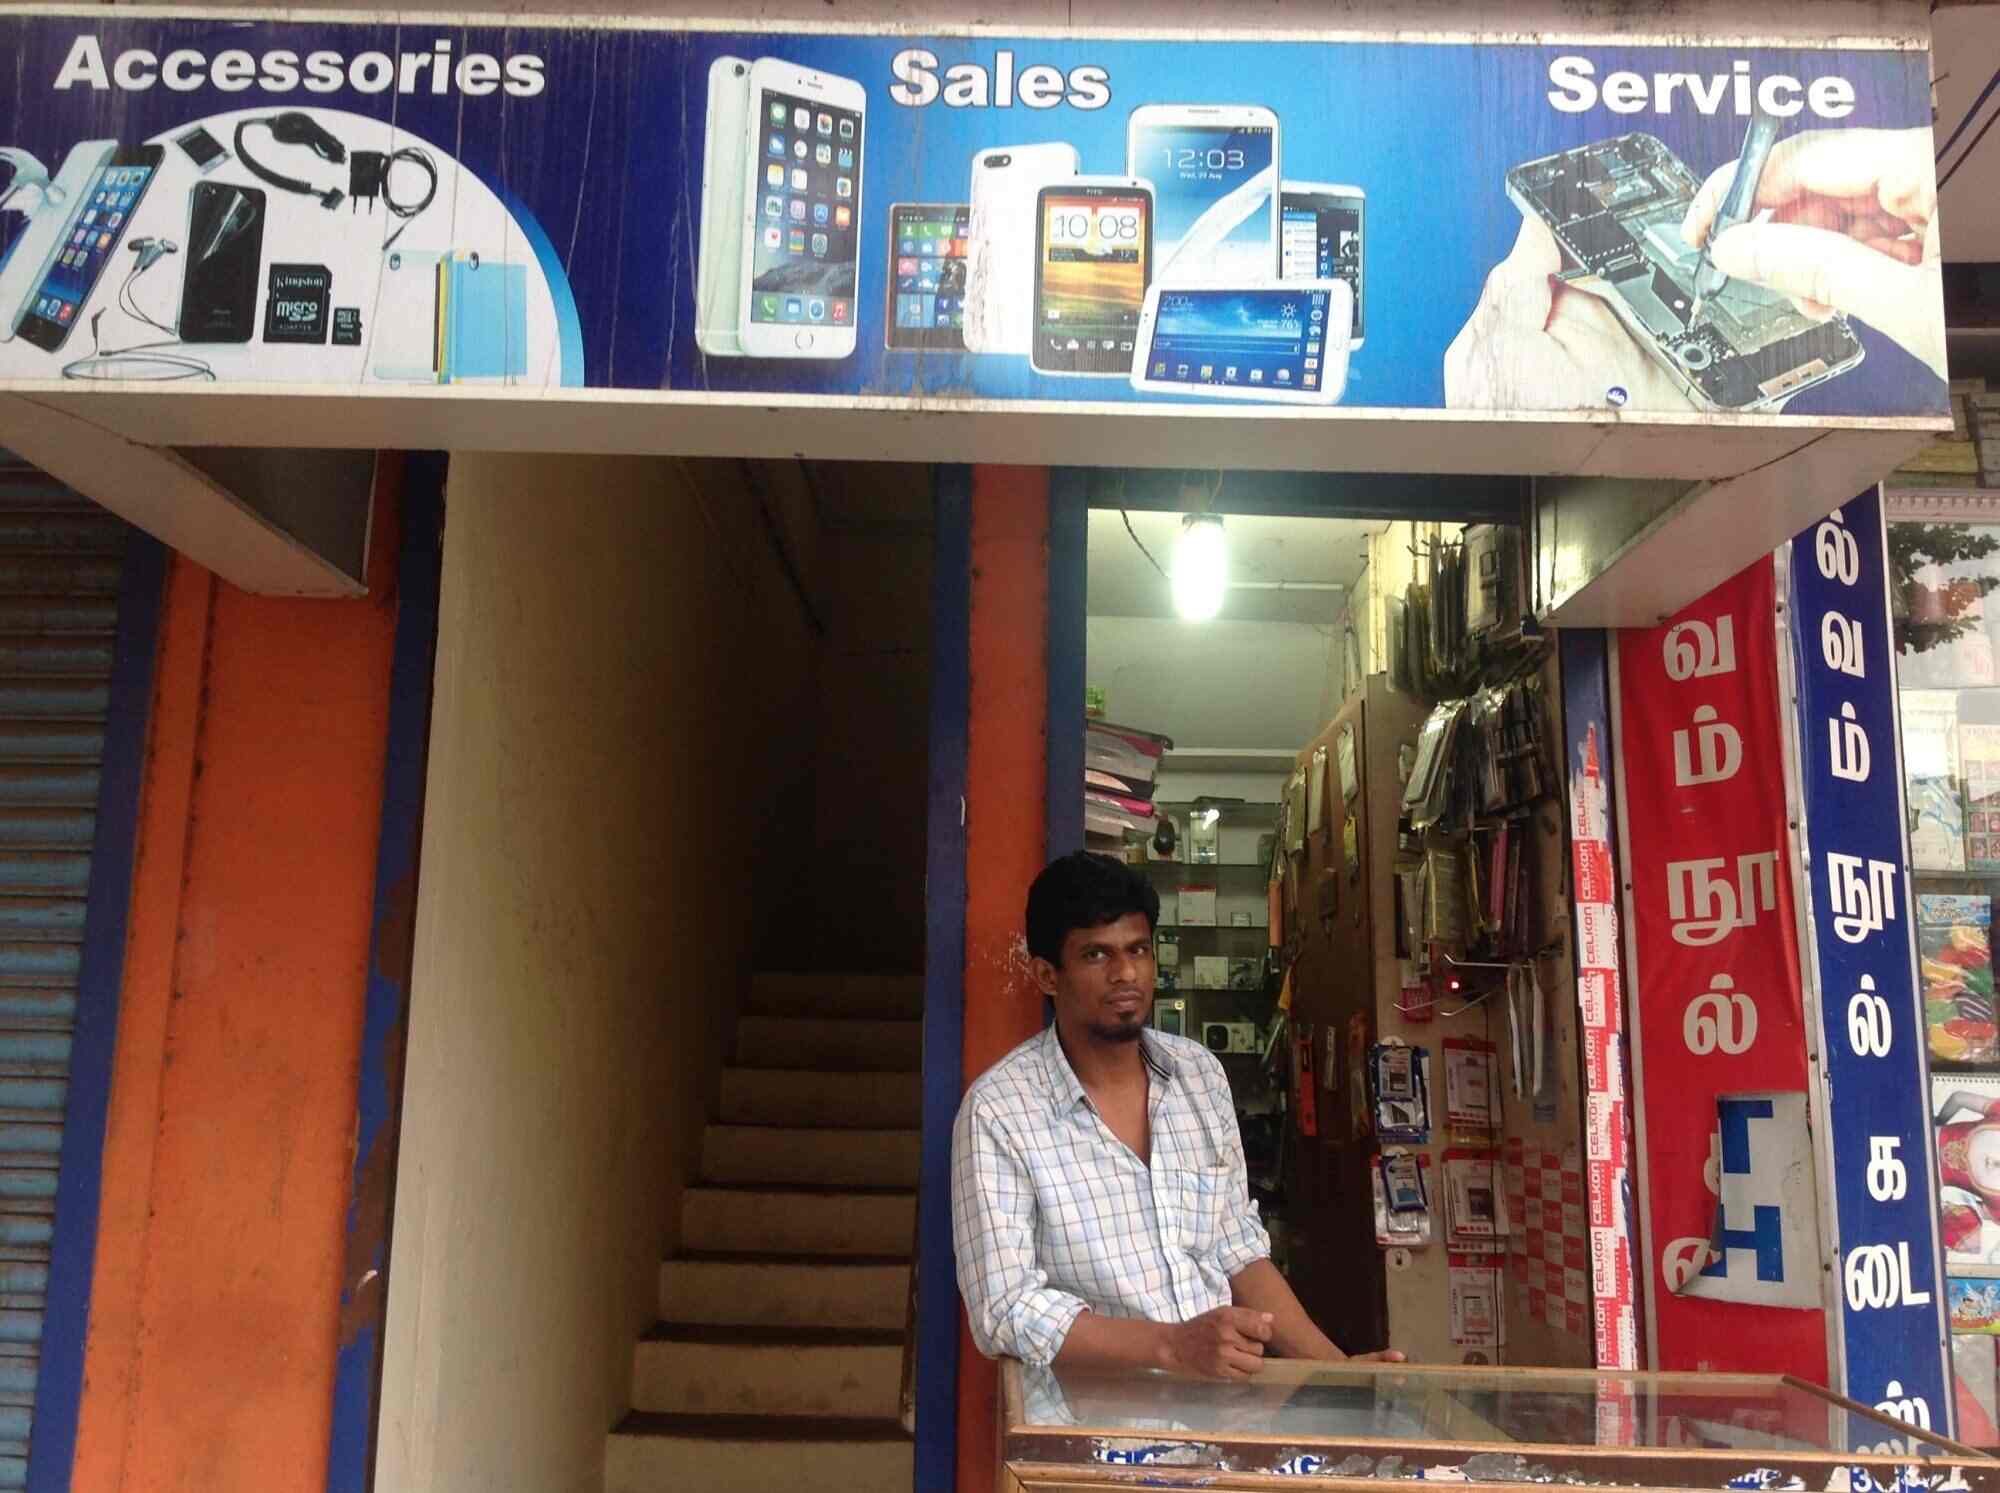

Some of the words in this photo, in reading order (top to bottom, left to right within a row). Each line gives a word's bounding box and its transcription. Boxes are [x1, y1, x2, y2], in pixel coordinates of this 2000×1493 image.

[53, 35, 545, 97] Accessories
[890, 48, 1111, 109] Sales
[1547, 55, 1857, 119] Service
[1163, 148, 1245, 170] 12:03
[276, 276, 323, 289] Kingston
[1583, 906, 1596, 964] CELKON
[1591, 1162, 1603, 1225] CELKON
[1594, 1231, 1605, 1294] CELKON
